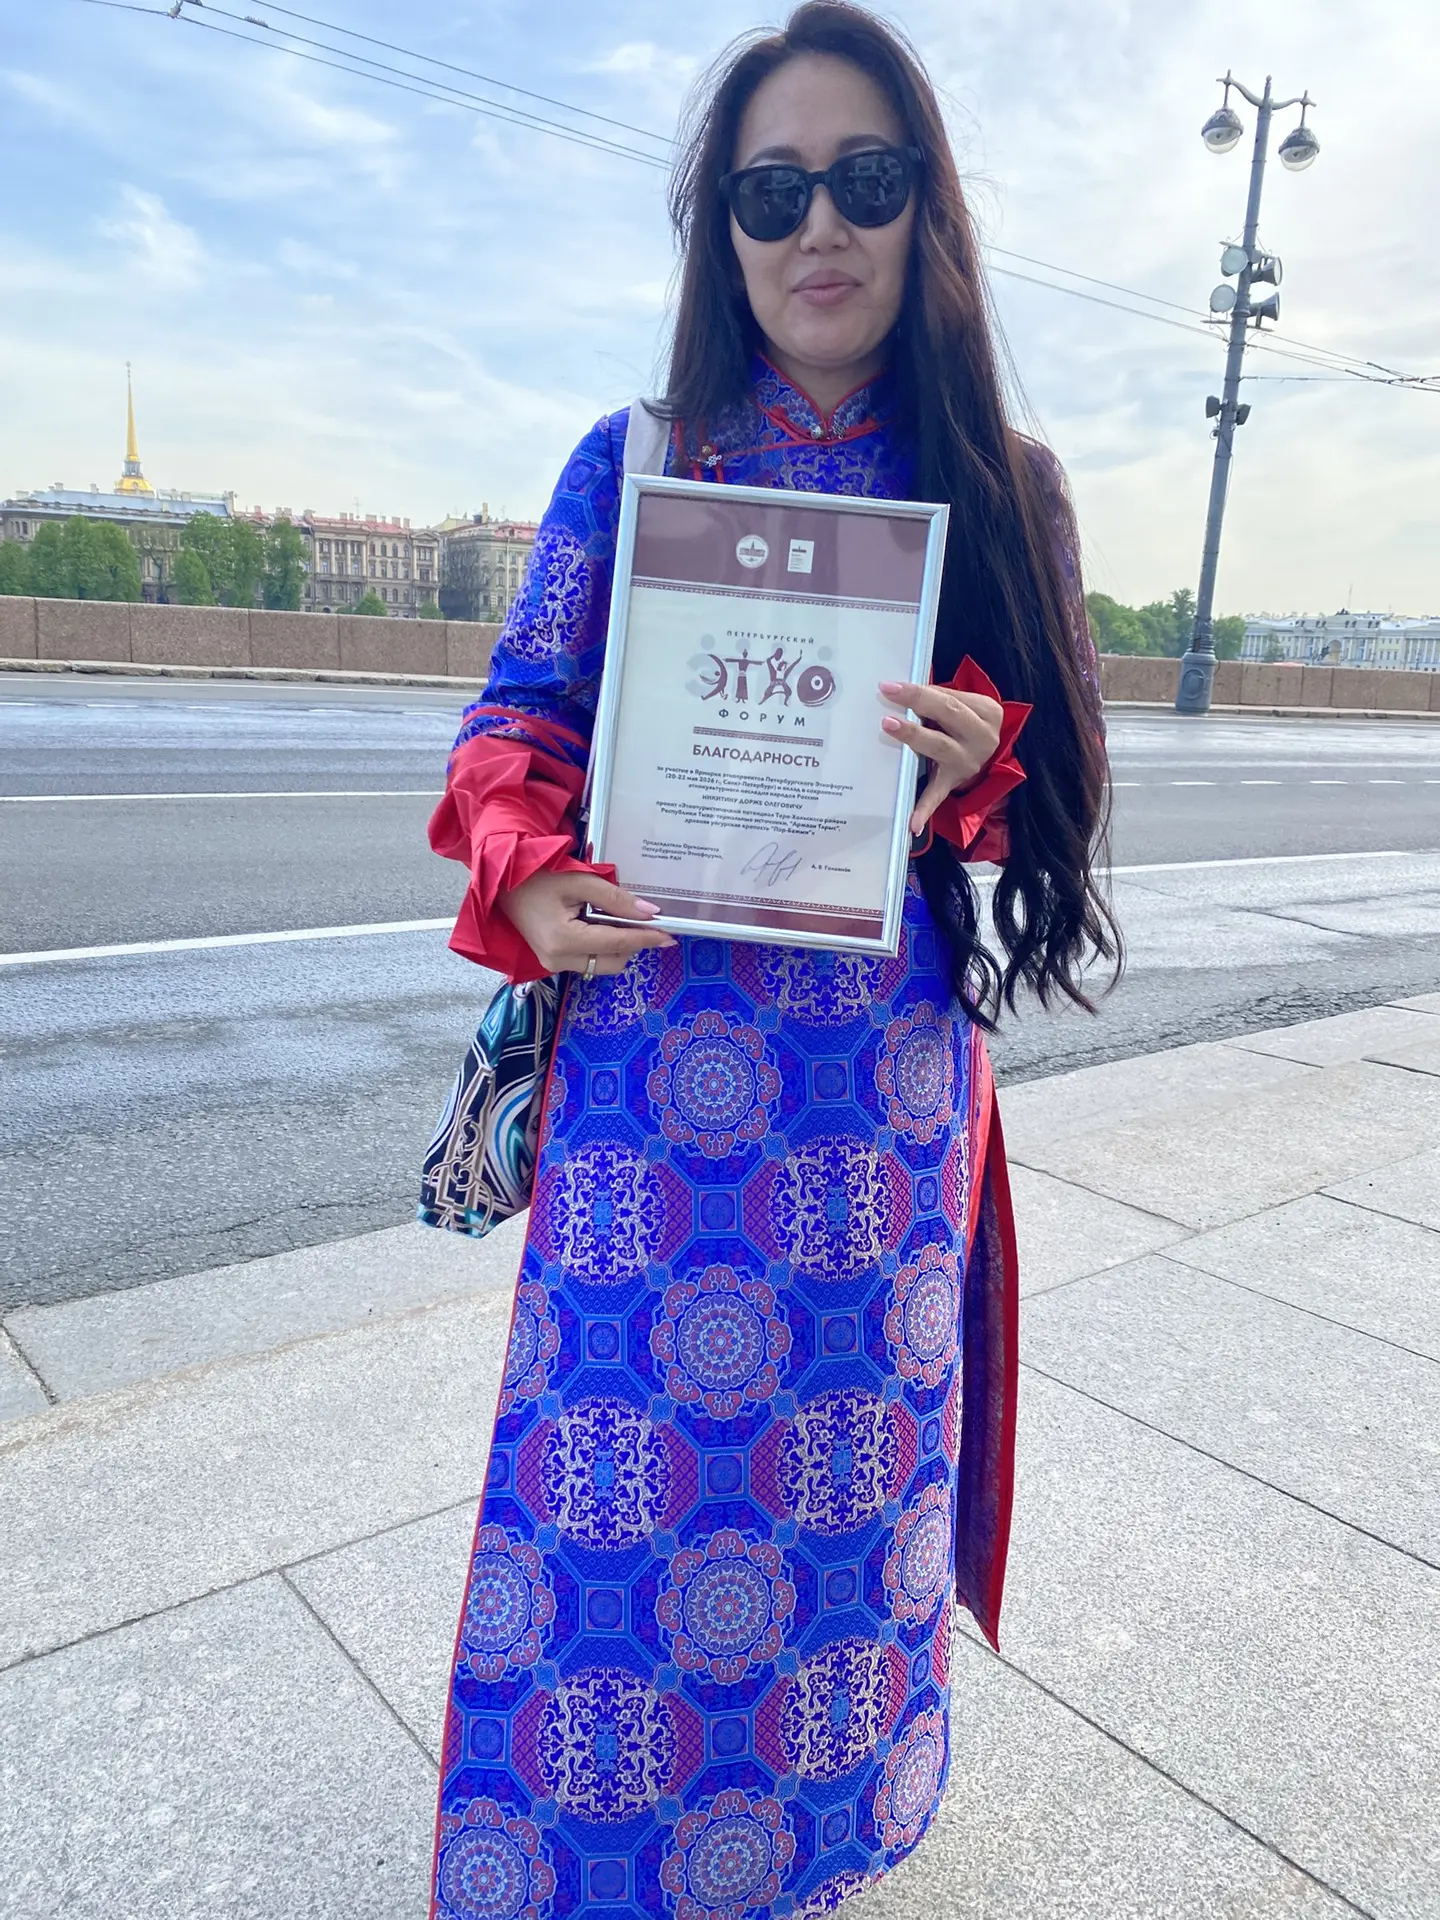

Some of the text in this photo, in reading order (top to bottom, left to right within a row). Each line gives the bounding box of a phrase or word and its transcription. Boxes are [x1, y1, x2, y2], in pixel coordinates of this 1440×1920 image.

[726, 630, 815, 644] ПЕТЕРБУРГСКИЙ
[718, 708, 805, 727] ФОРУМ
[693, 744, 819, 768] БЛАГОДАРНОСТЬ
[721, 779, 776, 790] Санкт-Петербург)
[722, 773, 764, 781] этнопроектов
[765, 776, 813, 787] Петербургского
[815, 781, 853, 790] Этнофорума
[688, 783, 738, 792] этнокультурного
[702, 794, 738, 802] НИКИТИНУ
[764, 801, 803, 809] ОЛЕГОВИЧУ
[716, 814, 752, 822] термальные
[741, 809, 774, 817] потенциал
[740, 823, 769, 831] крепость
[642, 846, 686, 855] Петербургского
